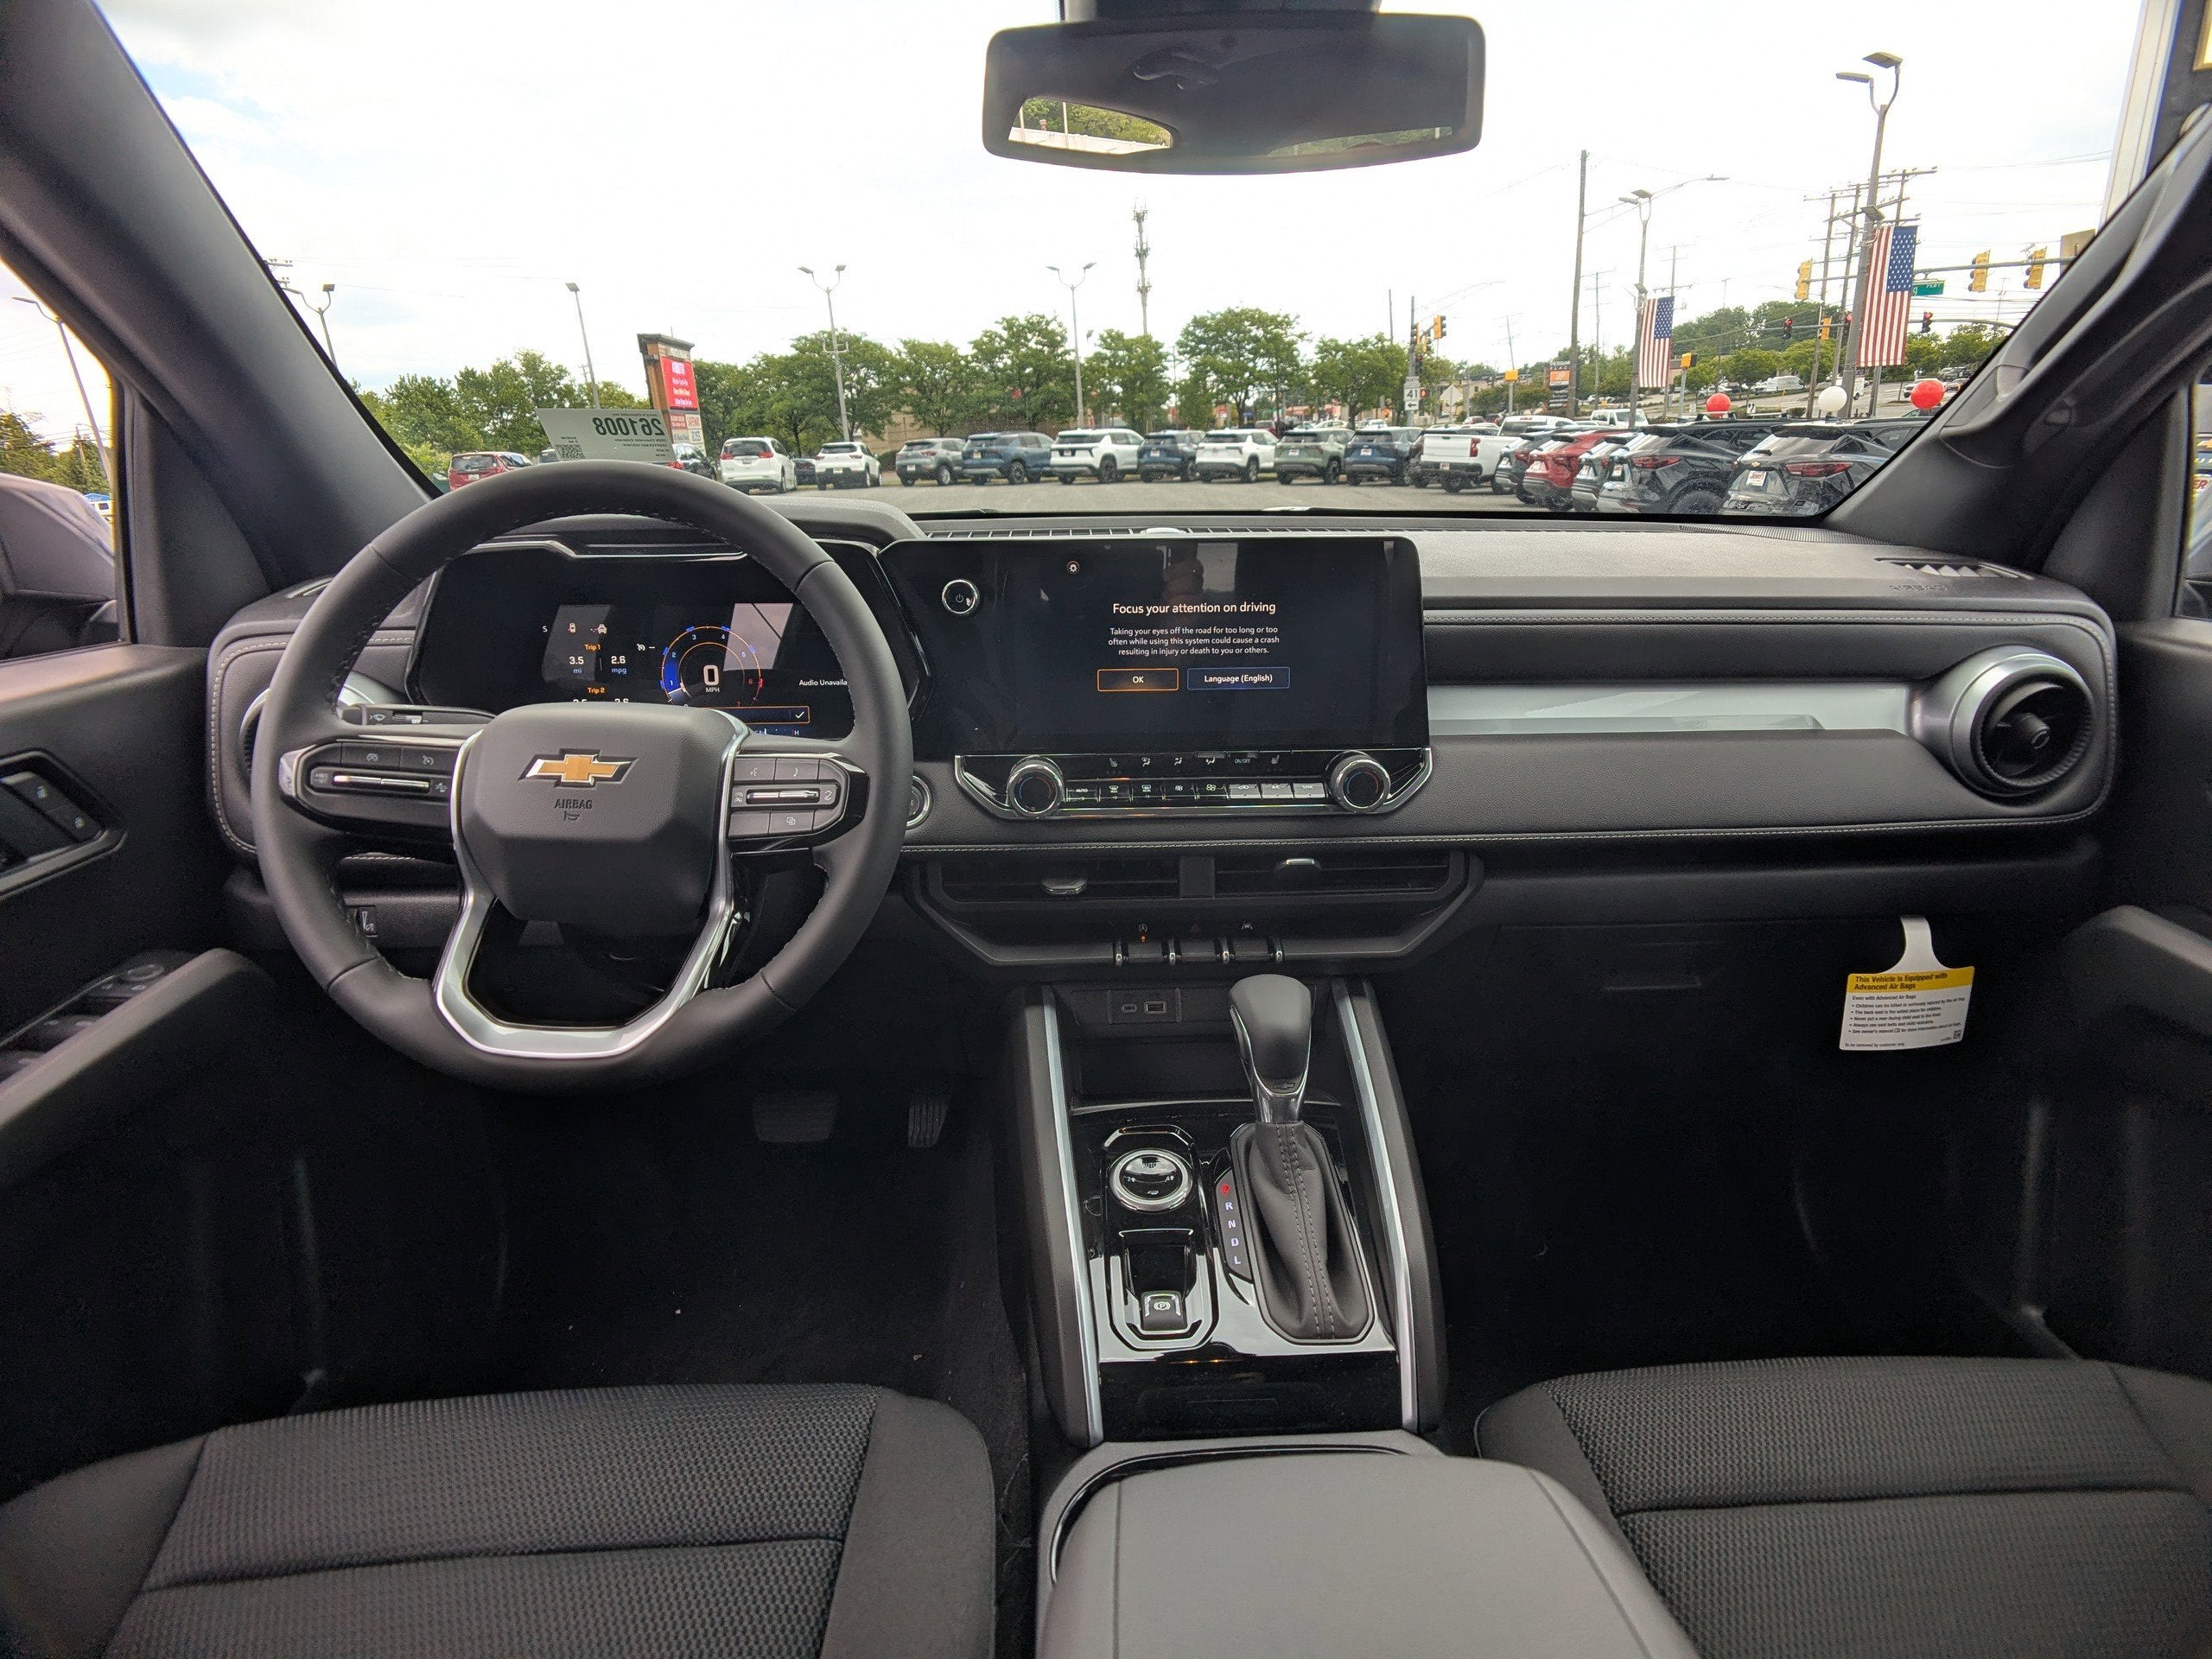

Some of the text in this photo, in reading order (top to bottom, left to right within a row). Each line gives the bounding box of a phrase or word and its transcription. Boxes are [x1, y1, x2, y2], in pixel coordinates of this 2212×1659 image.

[1407, 389, 1417, 398] 41
[1113, 604, 1144, 613] Focus
[1146, 605, 1170, 616] your
[1172, 603, 1220, 614] attention
[1239, 602, 1276, 614] driving
[1110, 627, 1133, 636] Taking
[1238, 626, 1255, 635] long
[1129, 637, 1148, 645] while
[1150, 637, 1168, 646] using
[1185, 637, 1210, 646] system
[584, 644, 597, 652] Trip
[1118, 647, 1149, 657] resulting
[1159, 647, 1179, 657] injury
[569, 656, 584, 665] 3.5
[611, 655, 626, 664] 2.6
[702, 664, 720, 686] 0
[1204, 674, 1273, 684] Language (English)
[554, 798, 594, 810] AIRBAG
[1222, 1184, 1230, 1194] P
[1225, 1201, 1234, 1211] R
[1228, 1219, 1236, 1229] N
[1230, 1237, 1239, 1247] D
[1234, 1255, 1242, 1265] L
